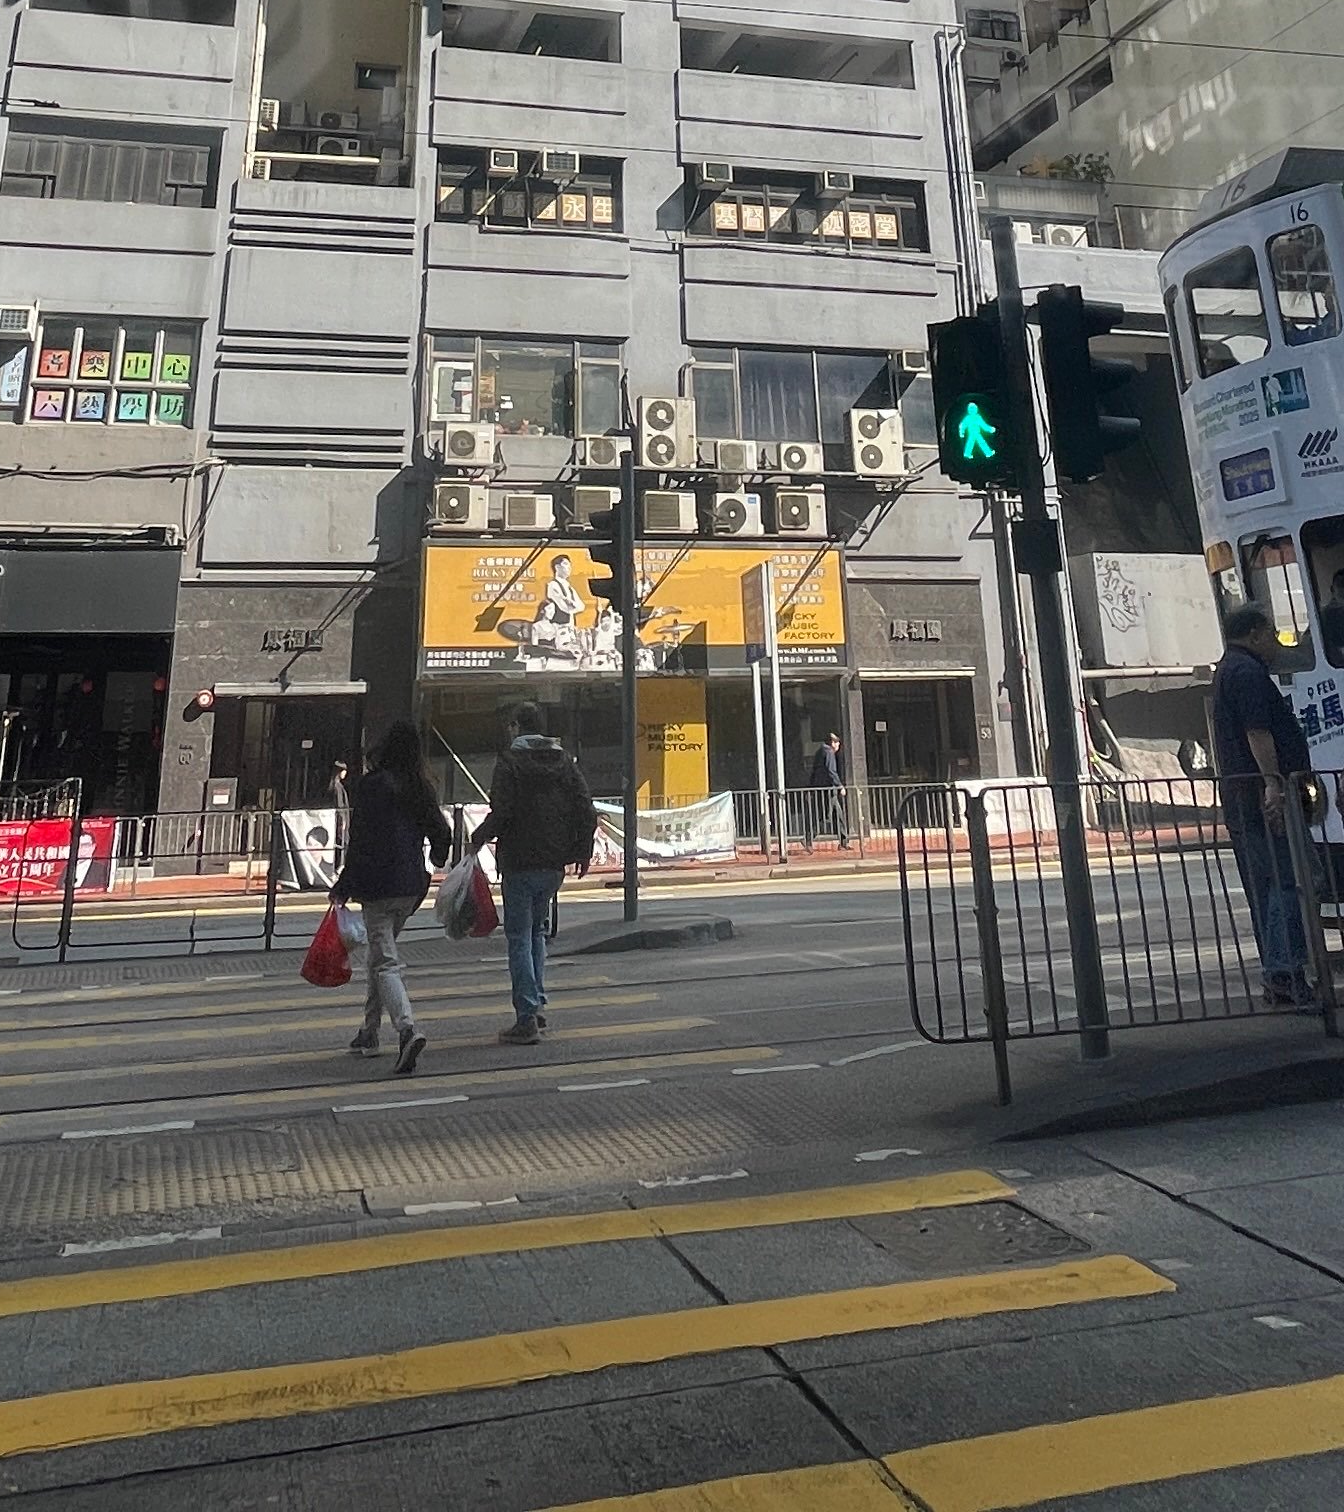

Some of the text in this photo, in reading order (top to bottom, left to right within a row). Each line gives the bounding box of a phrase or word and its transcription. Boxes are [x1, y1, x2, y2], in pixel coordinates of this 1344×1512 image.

[1219, 175, 1248, 210] 16
[1290, 201, 1309, 224] 16
[40, 394, 185, 417] 六藝學坊
[1303, 456, 1340, 470] HKAAA
[783, 622, 820, 630] MUSIC
[783, 631, 836, 640] FACTORY
[1316, 677, 1337, 696] FEB
[648, 733, 686, 742] MUSIC
[980, 726, 992, 740] 53
[648, 743, 704, 752] FACTORY
[178, 752, 194, 766] 60
